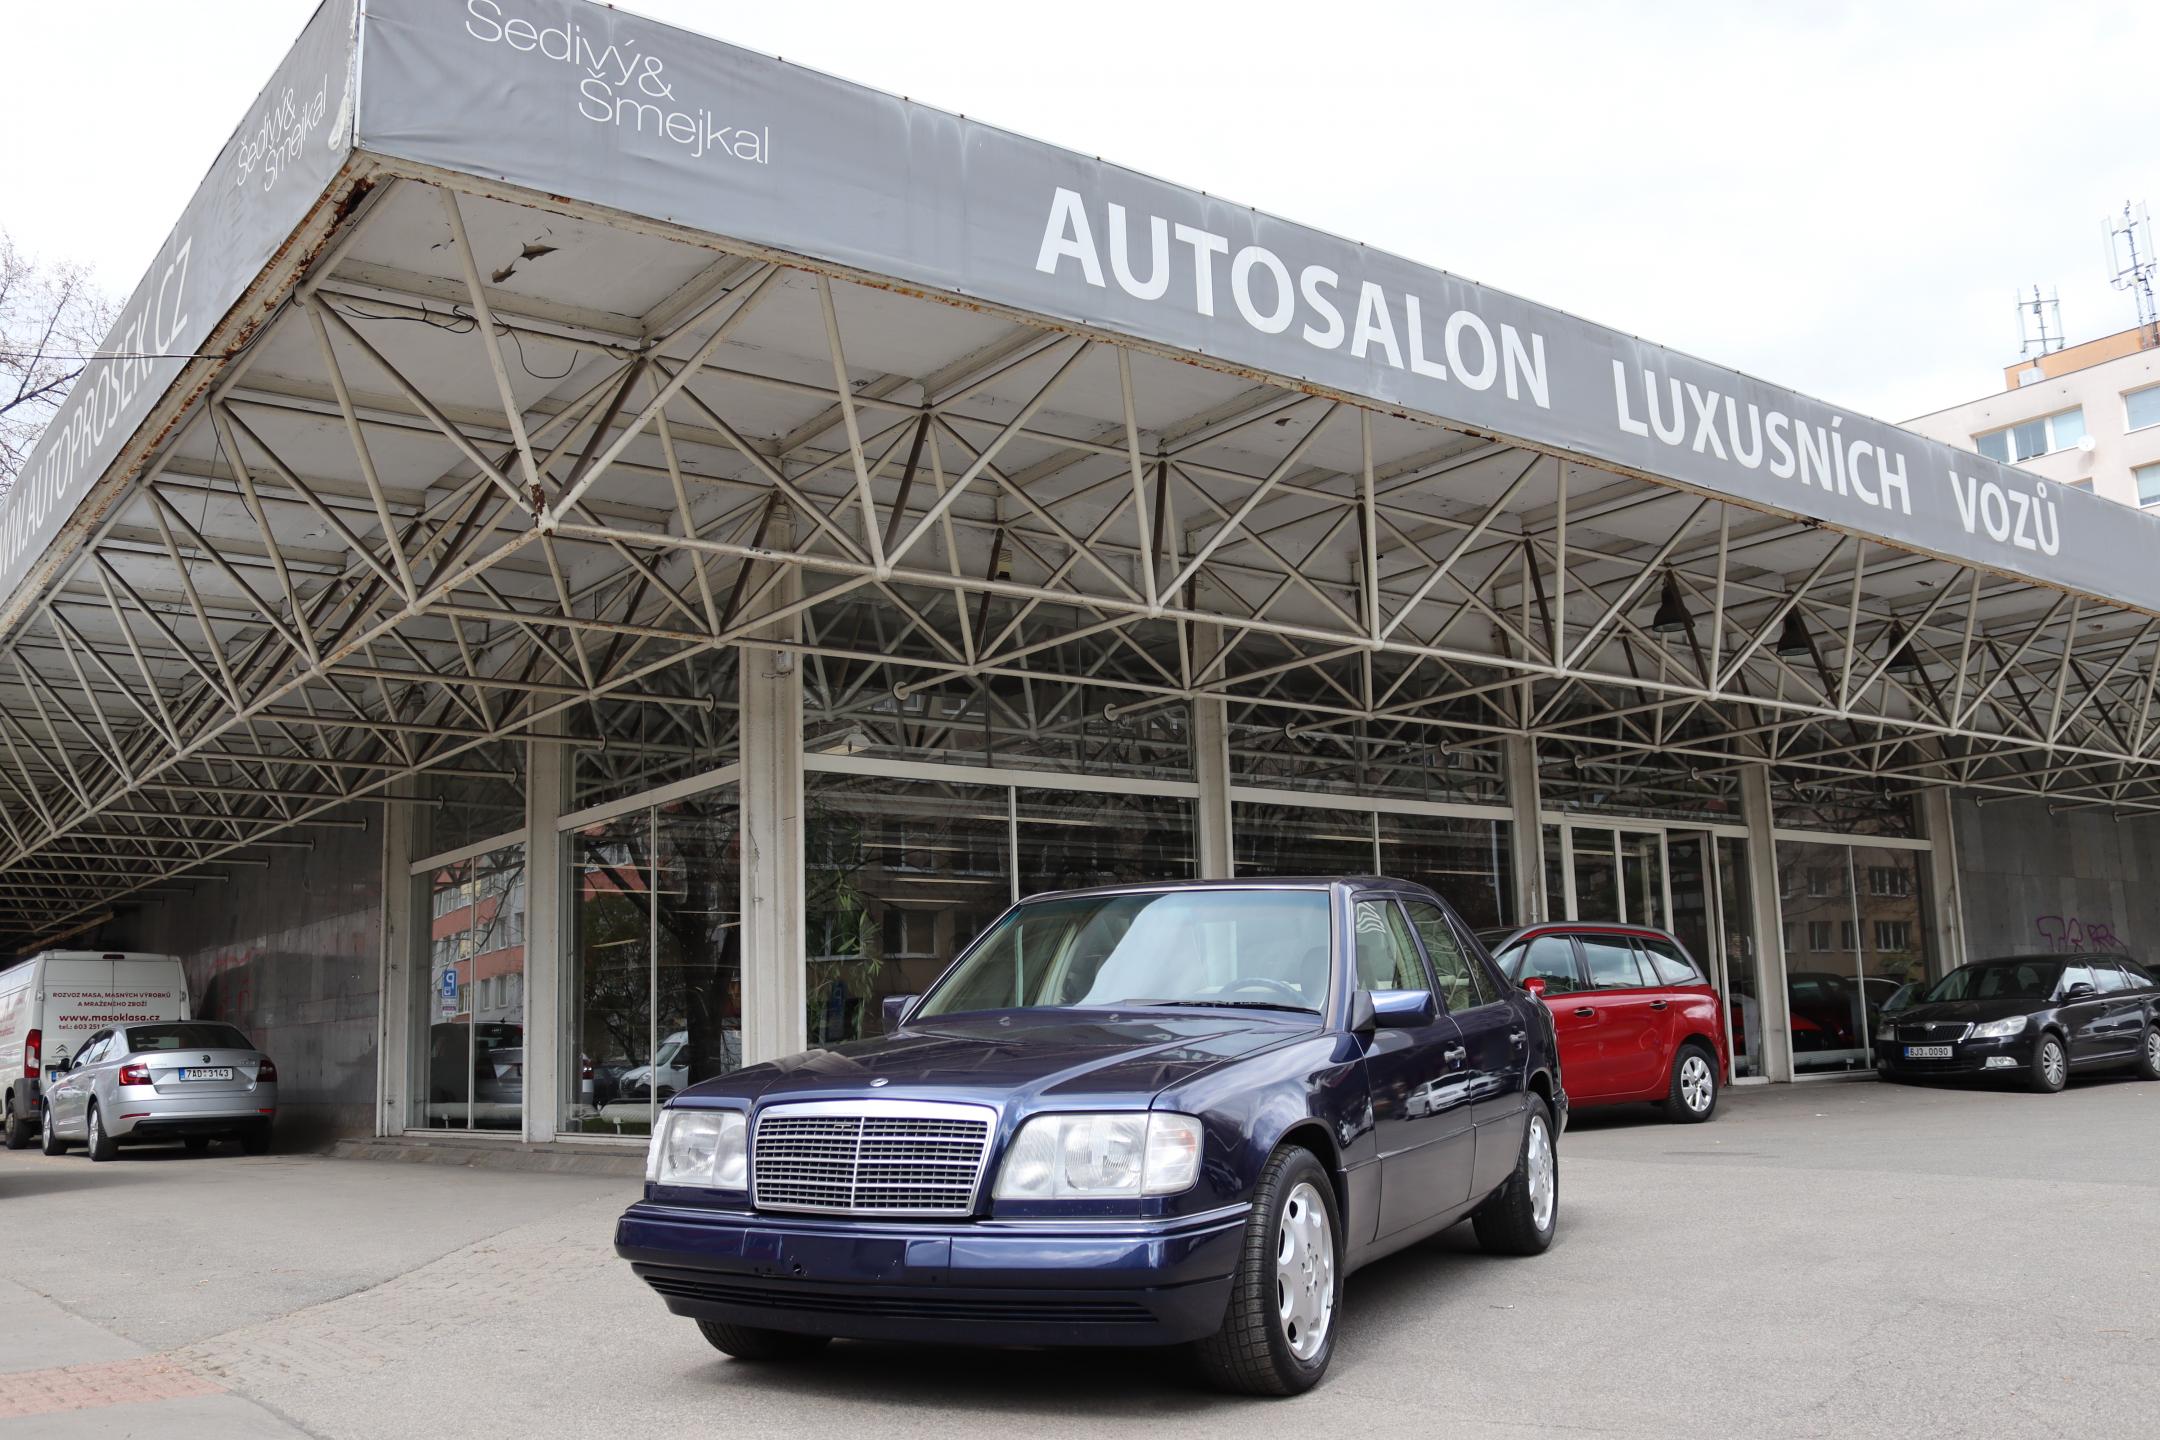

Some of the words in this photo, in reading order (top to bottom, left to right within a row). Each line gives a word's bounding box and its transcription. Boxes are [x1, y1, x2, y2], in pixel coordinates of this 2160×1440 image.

[264, 73, 328, 192] Šmejkal
[578, 67, 769, 164] Šmejkal
[1035, 186, 1551, 410] AUTOSALON
[1612, 359, 1912, 515] LUXUSNÍCH
[1949, 471, 2060, 556] VOZŮ
[59, 1013, 161, 1022] www.masoklasa.cz
[187, 1069, 204, 1078] 7AD
[208, 1069, 229, 1078] 3143
